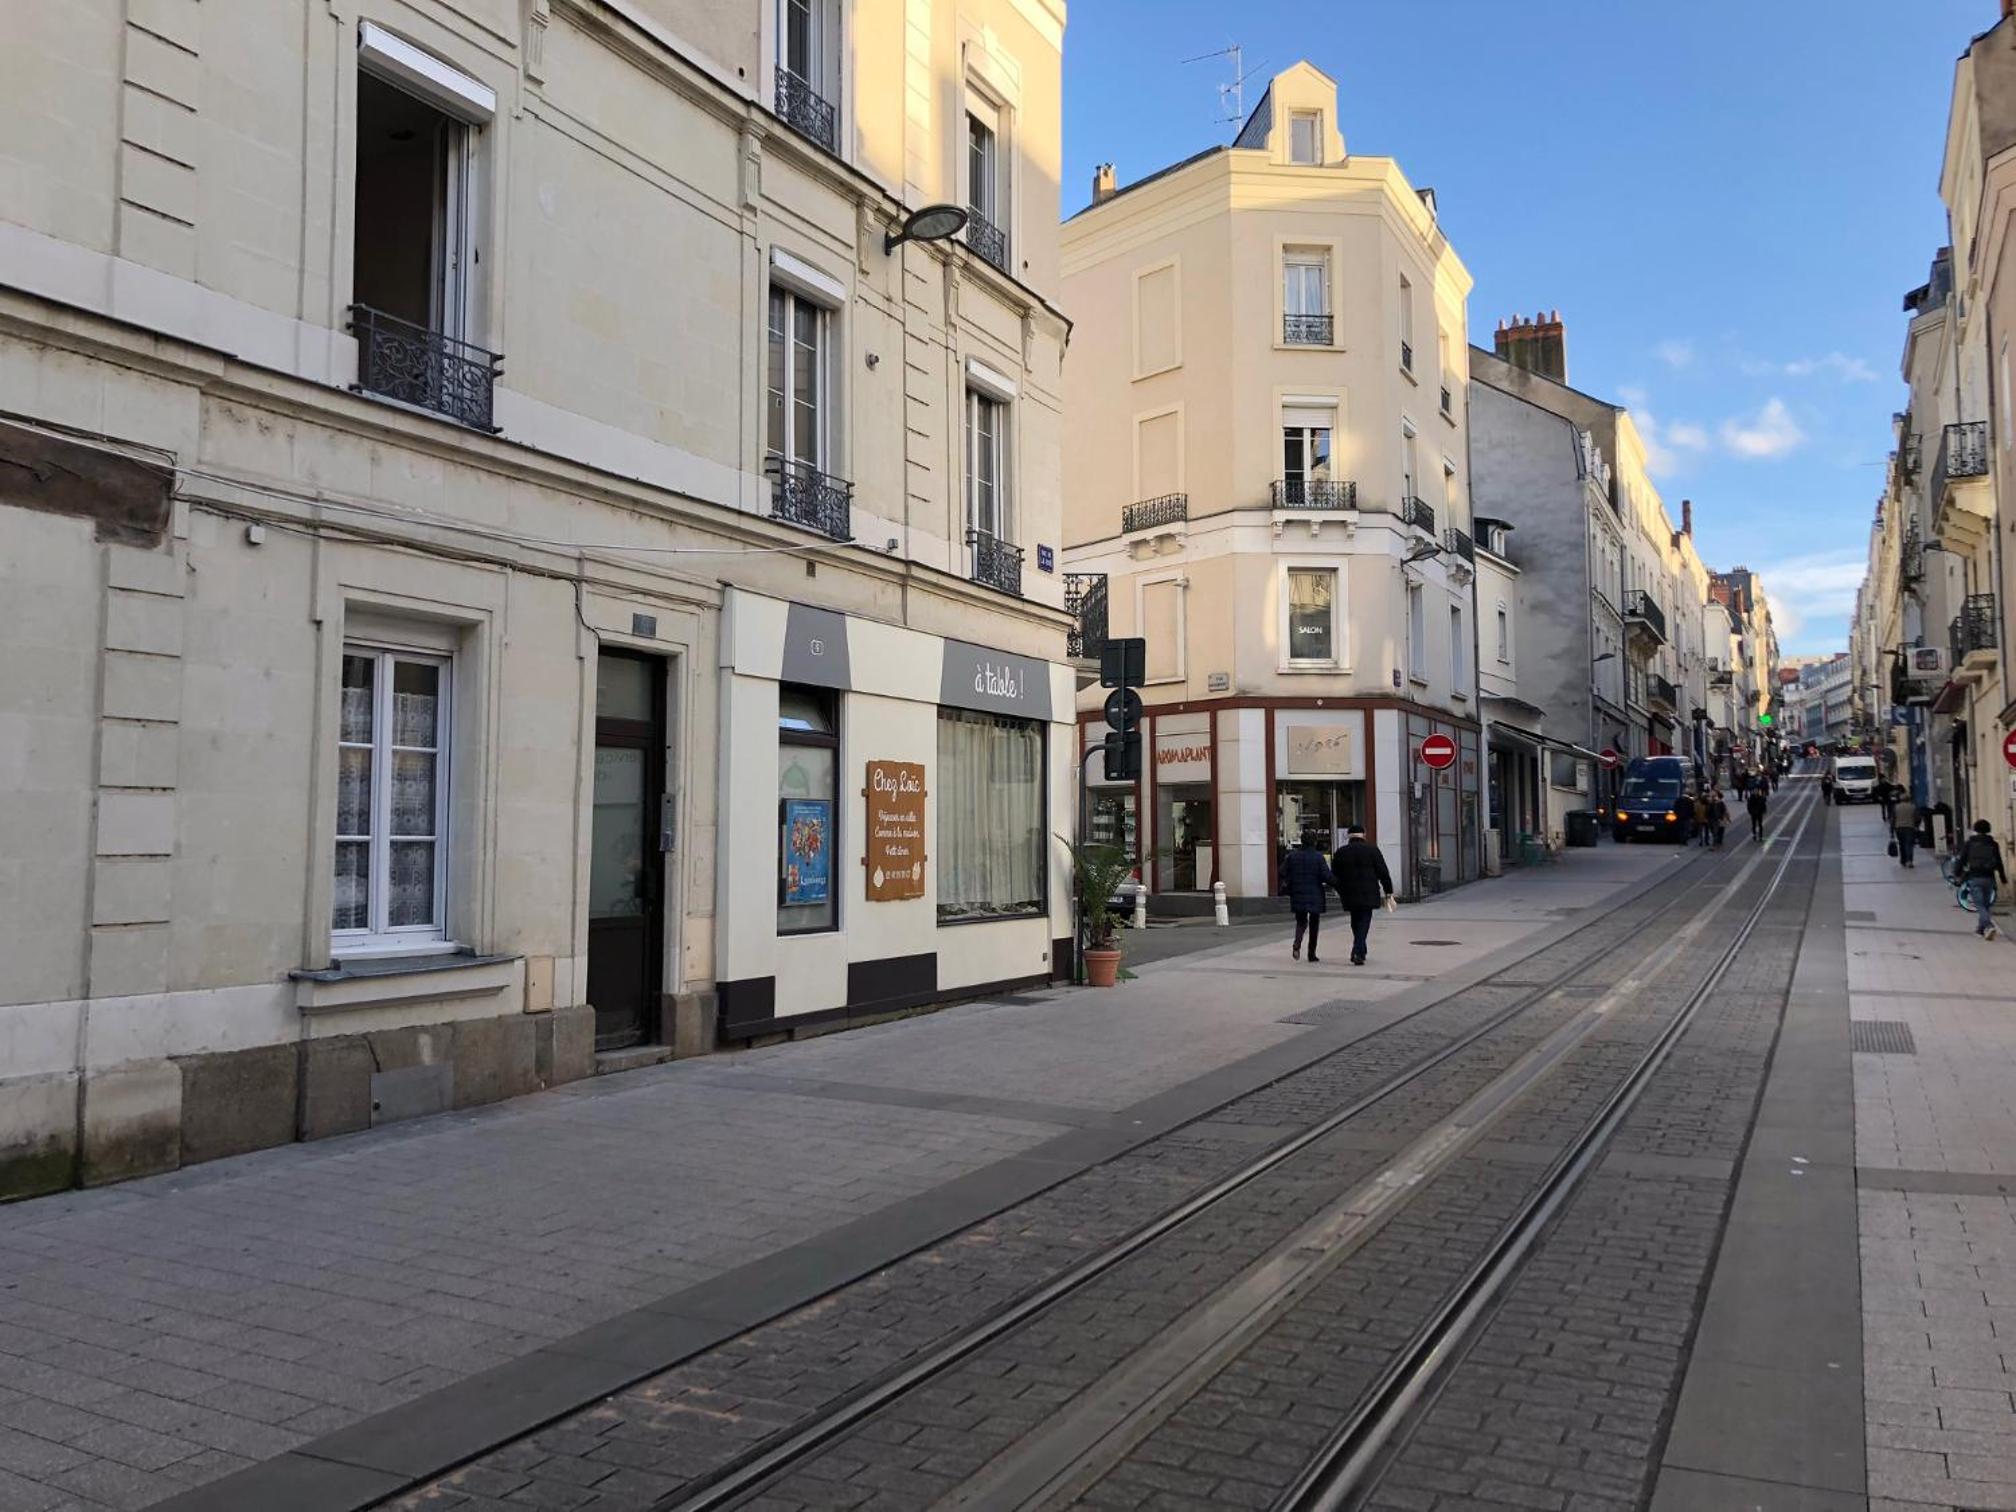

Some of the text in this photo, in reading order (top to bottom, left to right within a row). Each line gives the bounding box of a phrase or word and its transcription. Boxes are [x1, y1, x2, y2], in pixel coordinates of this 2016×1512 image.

[1297, 625, 1323, 635] SALON
[975, 663, 985, 693] à
[985, 661, 1017, 698] table
[873, 768, 921, 802] Chez Loïc
